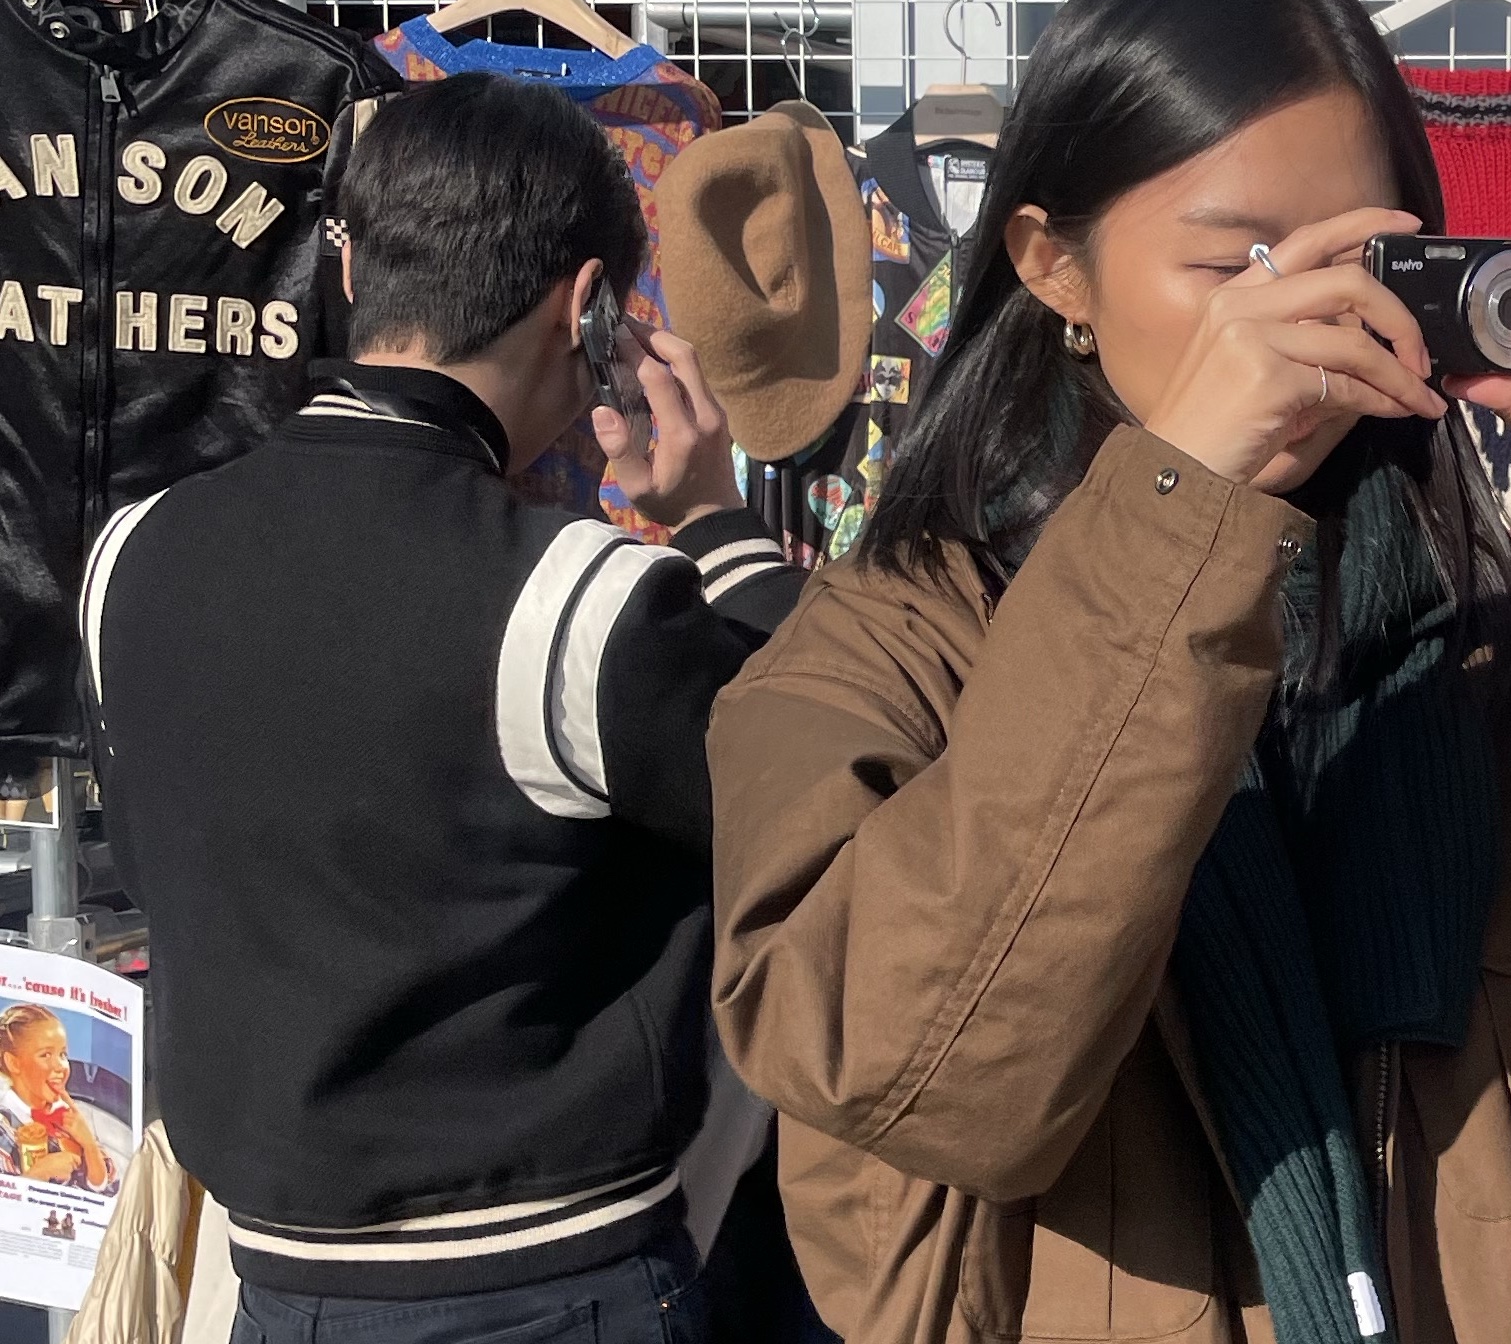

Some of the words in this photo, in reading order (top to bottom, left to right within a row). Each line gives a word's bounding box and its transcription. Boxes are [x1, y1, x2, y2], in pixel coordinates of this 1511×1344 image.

[222, 110, 317, 137] vanson
[232, 131, 310, 153] Leathers
[1391, 258, 1424, 273] SANYO
